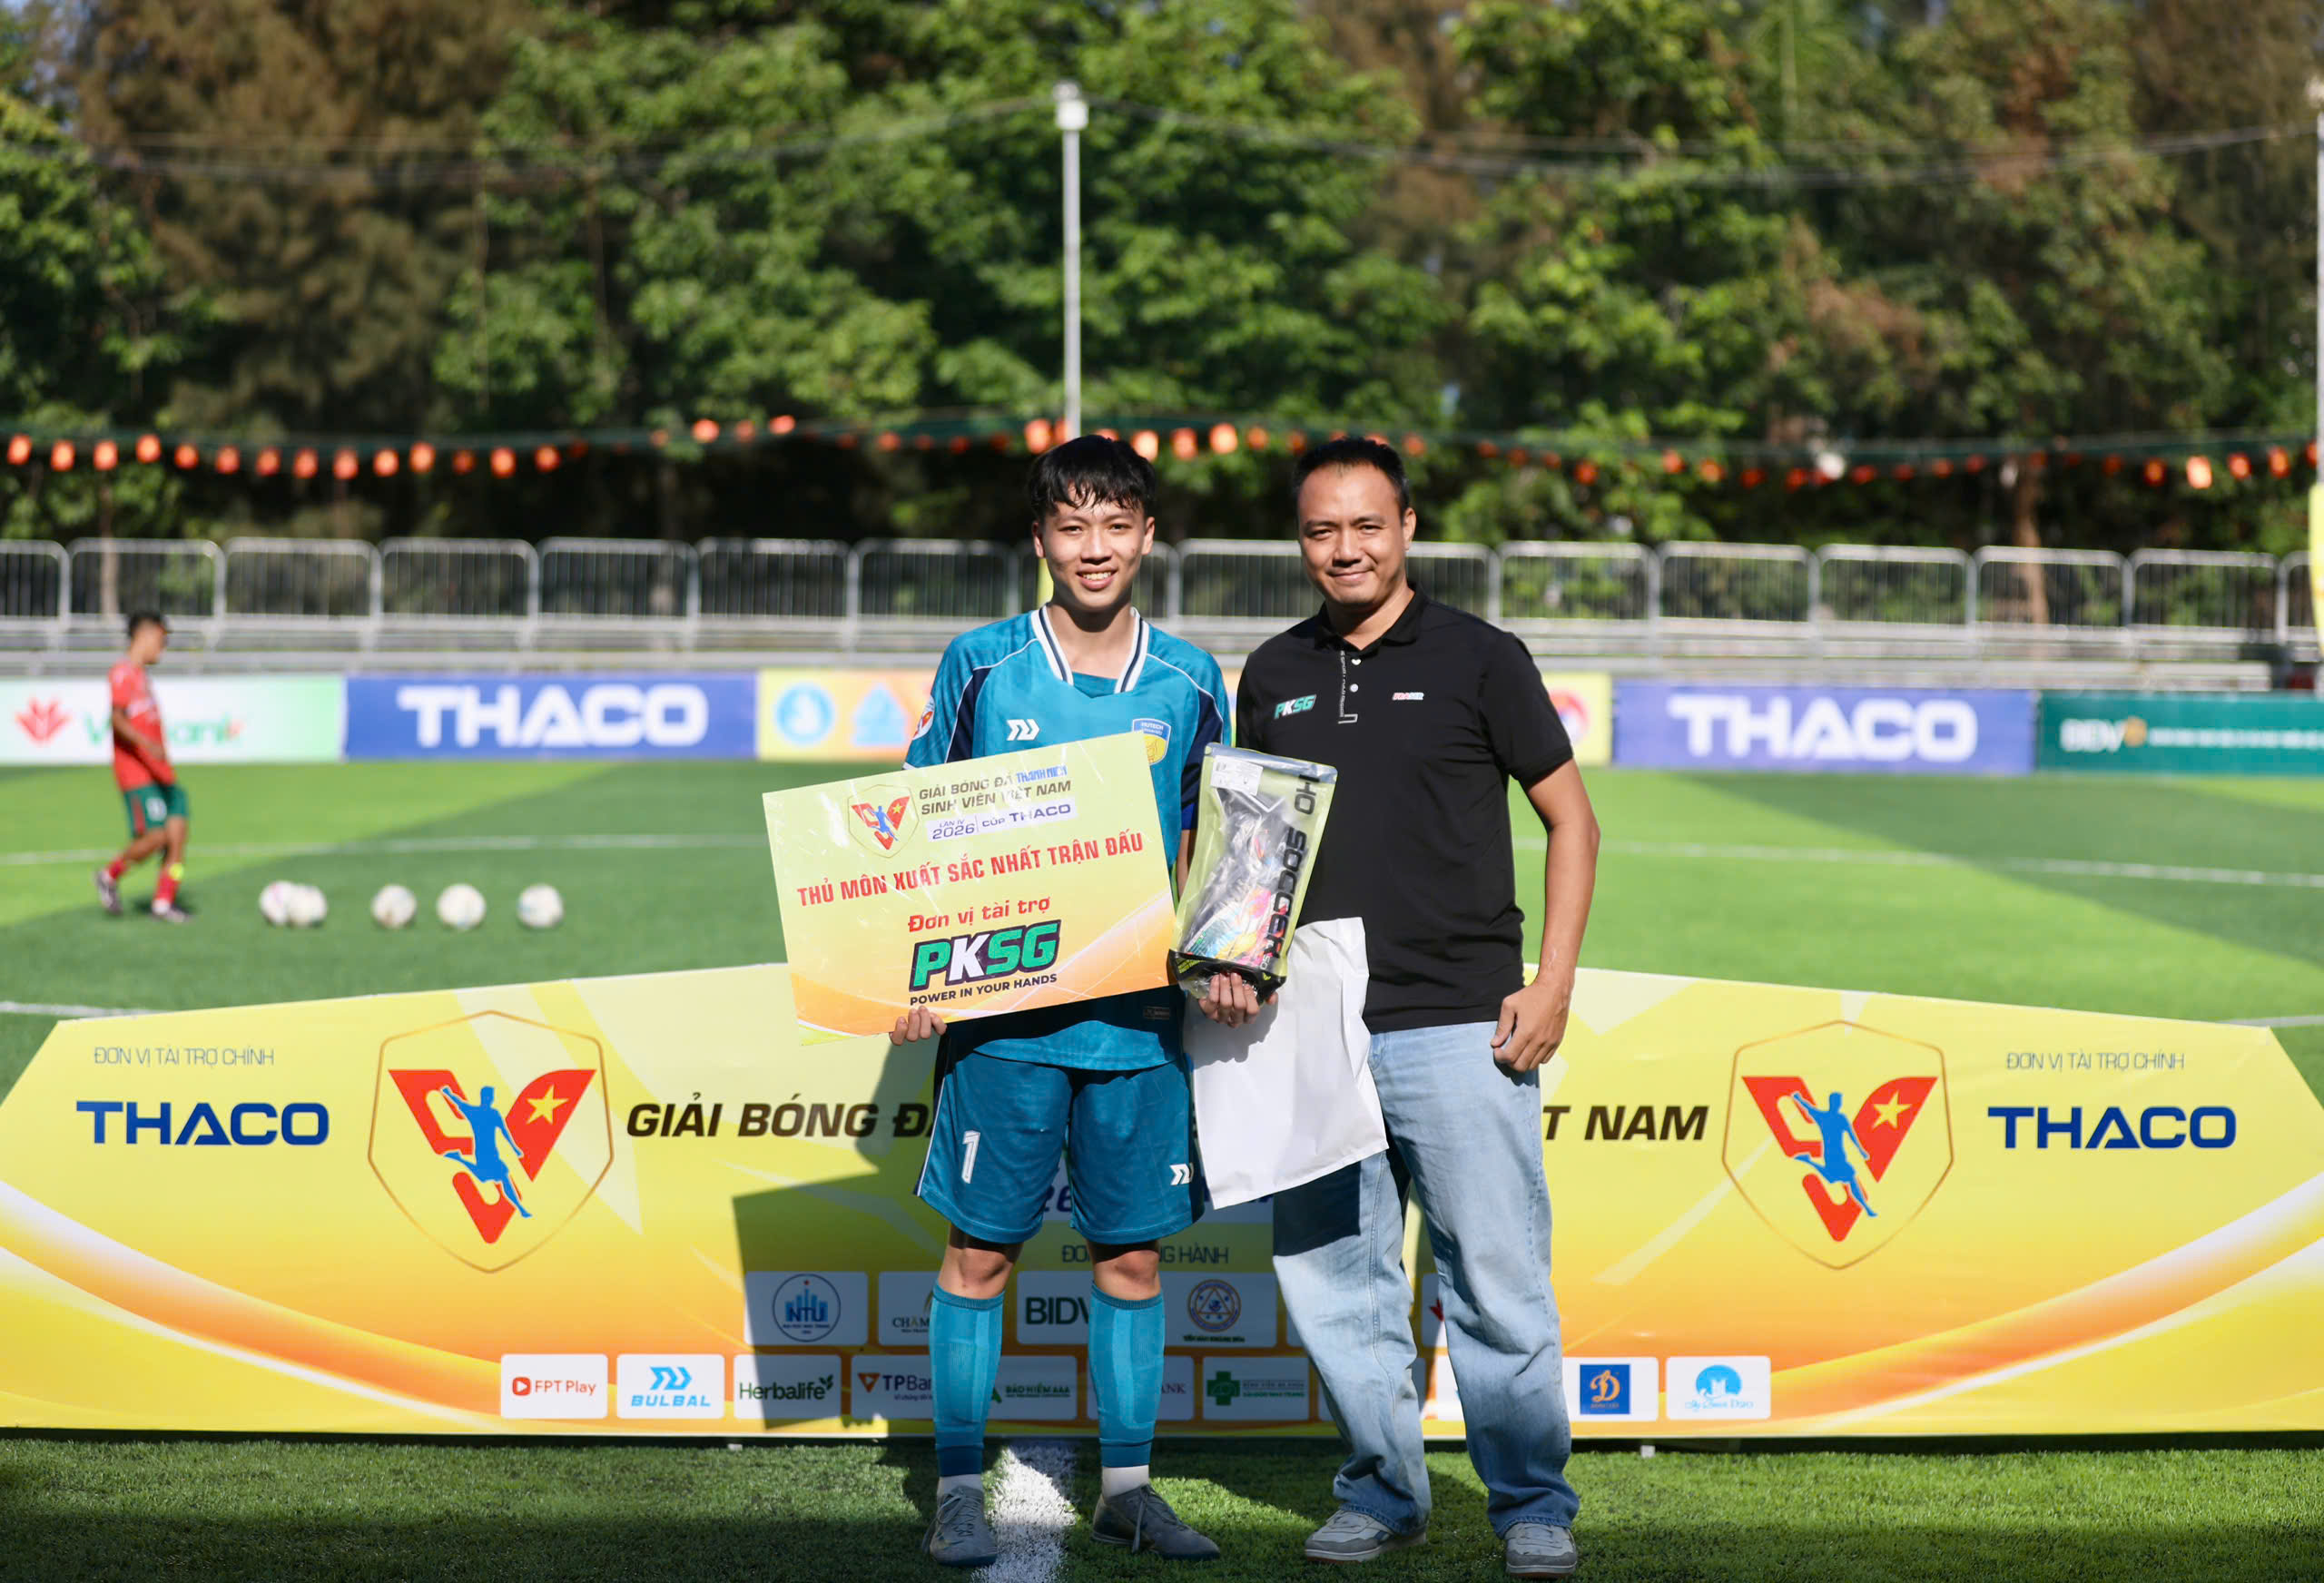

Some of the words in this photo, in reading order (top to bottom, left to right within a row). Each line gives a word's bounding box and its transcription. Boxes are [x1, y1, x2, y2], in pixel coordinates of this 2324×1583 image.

[398, 685, 709, 746] THACO
[1274, 694, 1316, 719] PKSG
[1669, 695, 1978, 762] THACO
[962, 790, 996, 809] VIÊN
[1036, 781, 1071, 798] NAM
[1294, 773, 1320, 815] HO
[1009, 803, 1071, 823] THACO
[932, 822, 975, 840] 2026
[797, 877, 834, 907] THỦ
[841, 869, 888, 900] MÔN
[894, 863, 940, 893] XUẤT
[948, 852, 986, 882] SẮC
[991, 843, 1041, 877] NHẤT
[1047, 840, 1099, 869] TRẬN
[1105, 829, 1144, 856] ĐẤU
[1269, 827, 1308, 959] SOCCER
[908, 912, 950, 933] Đơn
[957, 909, 974, 928] vị
[981, 900, 1009, 920] tài
[1018, 896, 1051, 917] trợ
[910, 919, 1061, 992] PKSG
[910, 990, 956, 1007] POWER
[960, 987, 972, 998] IN
[976, 982, 1009, 997] YOUR
[1013, 974, 1058, 990] HANDS
[94, 1047, 132, 1065] ĐƠN
[135, 1048, 152, 1067] VỊ
[153, 1045, 181, 1066] TÀI
[183, 1047, 218, 1067] TRỢ
[222, 1045, 274, 1066] CHÍNH
[2006, 1053, 2043, 1070] ĐƠN
[2049, 1053, 2063, 1073] VỊ
[2070, 1049, 2092, 1069] TÀI
[2097, 1052, 2130, 1072] TRỢ
[2133, 1048, 2184, 1069] CHÍNH
[76, 1100, 330, 1145] THACO
[626, 1092, 723, 1137] GIẢI
[737, 1093, 879, 1137] BÓNG
[892, 1102, 934, 1137] Đ
[1584, 1106, 1709, 1140] NAM
[1987, 1106, 2237, 1149] THACO
[961, 1130, 980, 1184] 1
[1179, 1242, 1228, 1263] HÀNH
[789, 1307, 825, 1322] NTU
[535, 1380, 561, 1393] FPT
[566, 1379, 596, 1396] Play
[739, 1379, 825, 1401] Herbalife
[883, 1374, 931, 1391] TPBa
[631, 1395, 711, 1407] BULBAL
